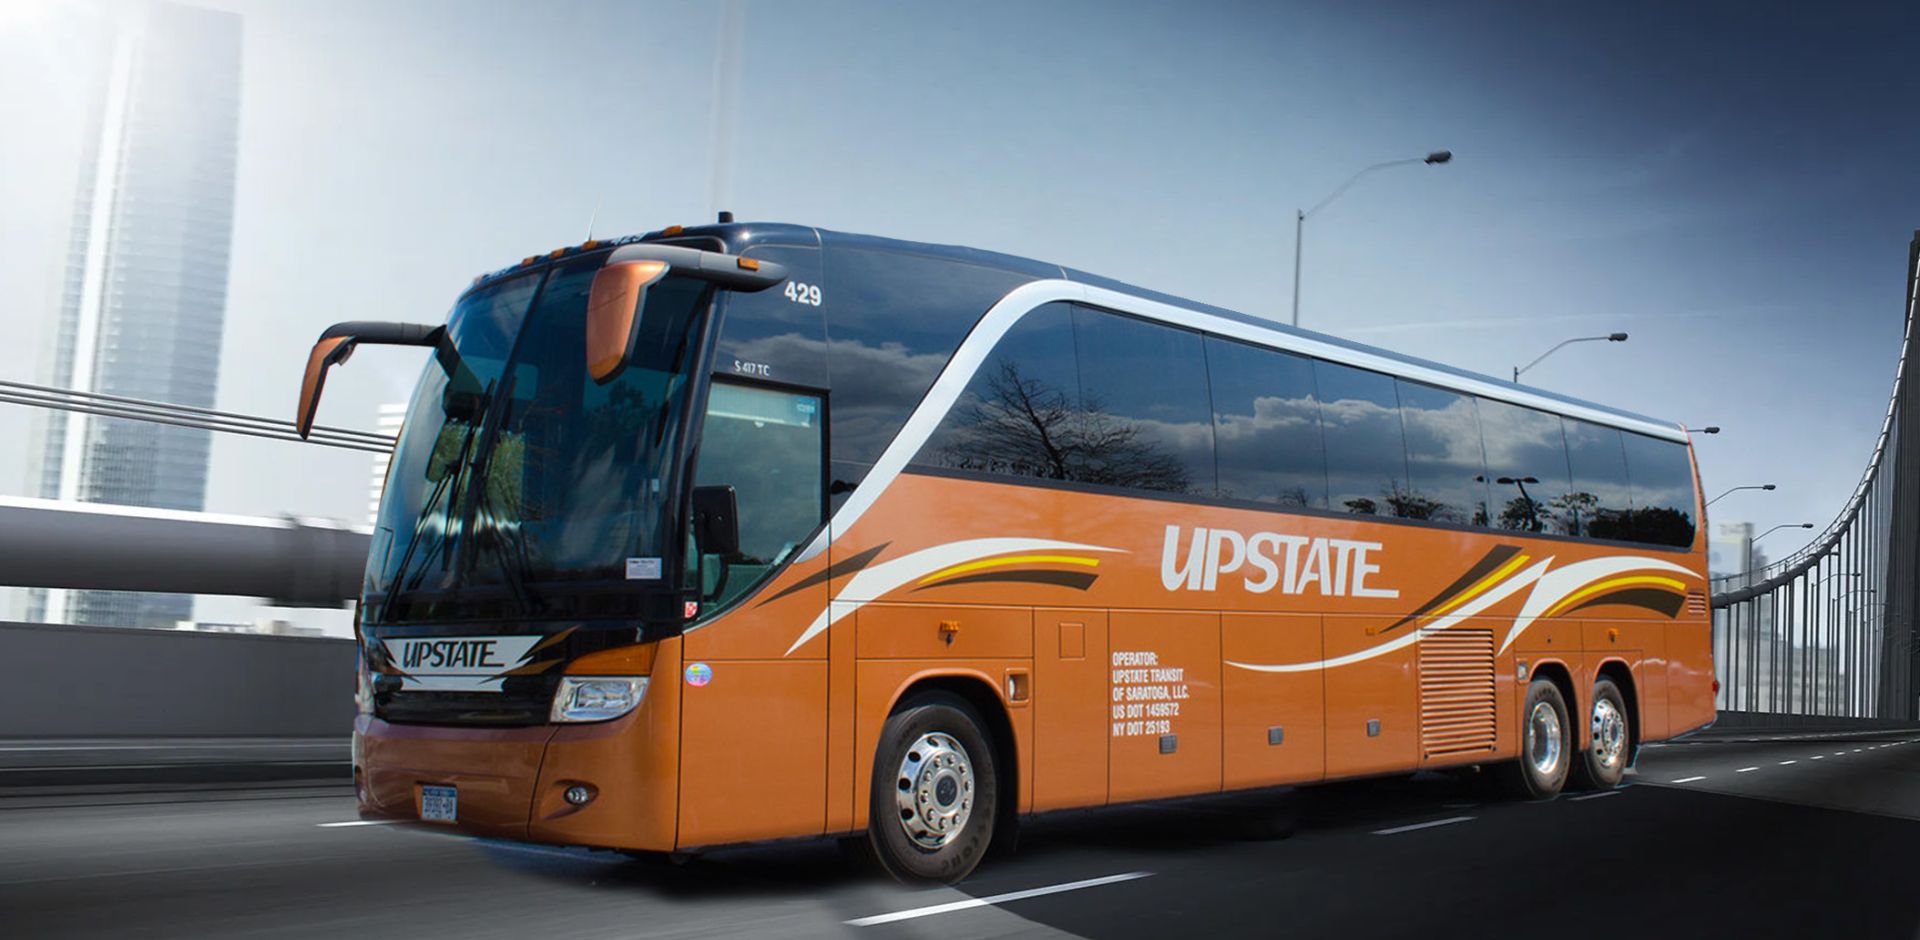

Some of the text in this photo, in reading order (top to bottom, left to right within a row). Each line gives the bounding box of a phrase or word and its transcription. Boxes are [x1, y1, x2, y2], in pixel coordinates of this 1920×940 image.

[784, 281, 822, 306] 429
[734, 360, 770, 376] S 417 TC
[1161, 525, 1399, 598] UPSTATE
[402, 640, 505, 667] UPSTATE
[1112, 651, 1159, 666] OPERATOR:
[1112, 668, 1184, 684] UPSTATE TRANSIT
[1113, 685, 1190, 702] OF SARATOGA, LLC.
[1113, 704, 1125, 719] US
[1127, 703, 1144, 718] DOT
[1113, 722, 1125, 737] NY
[1127, 721, 1144, 736] DOT
